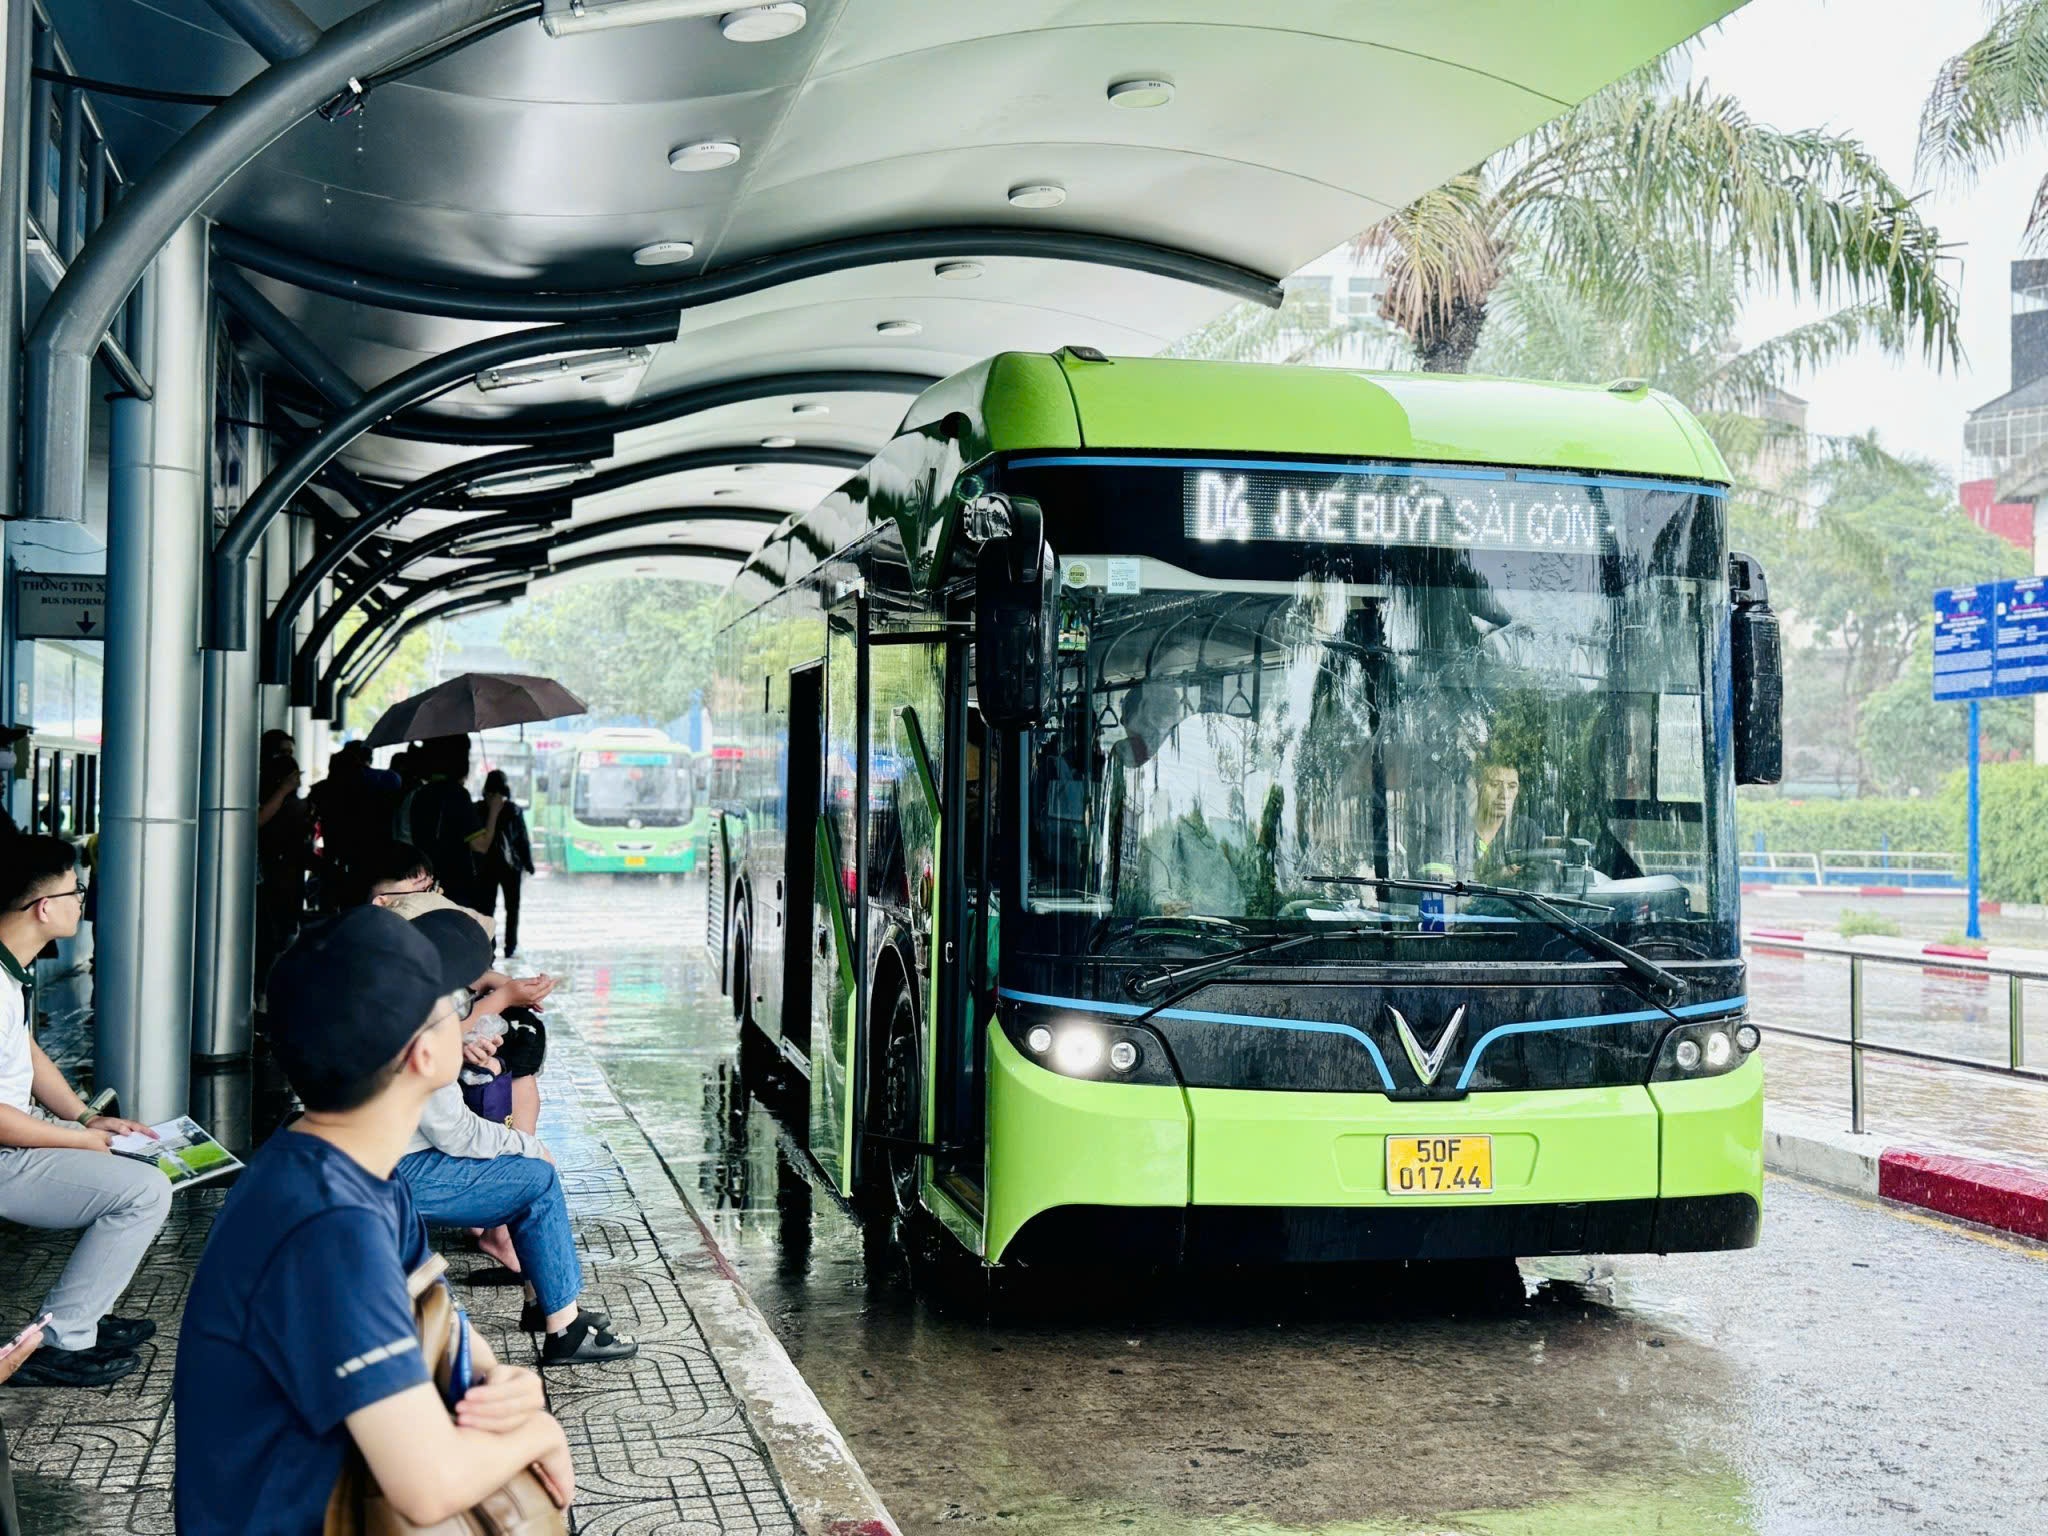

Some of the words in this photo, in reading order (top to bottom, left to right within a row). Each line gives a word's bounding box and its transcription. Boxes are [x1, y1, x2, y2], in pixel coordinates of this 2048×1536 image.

[1197, 471, 1250, 542] D4
[1297, 491, 1347, 537] XE
[1357, 484, 1444, 541] BUÝT
[1454, 488, 1515, 543] SÀI
[1526, 490, 1596, 546] GÒN
[72, 582, 92, 593] TIN
[41, 596, 60, 605] BUS
[1417, 1139, 1462, 1163] 50F
[1399, 1165, 1482, 1190] 017.44
